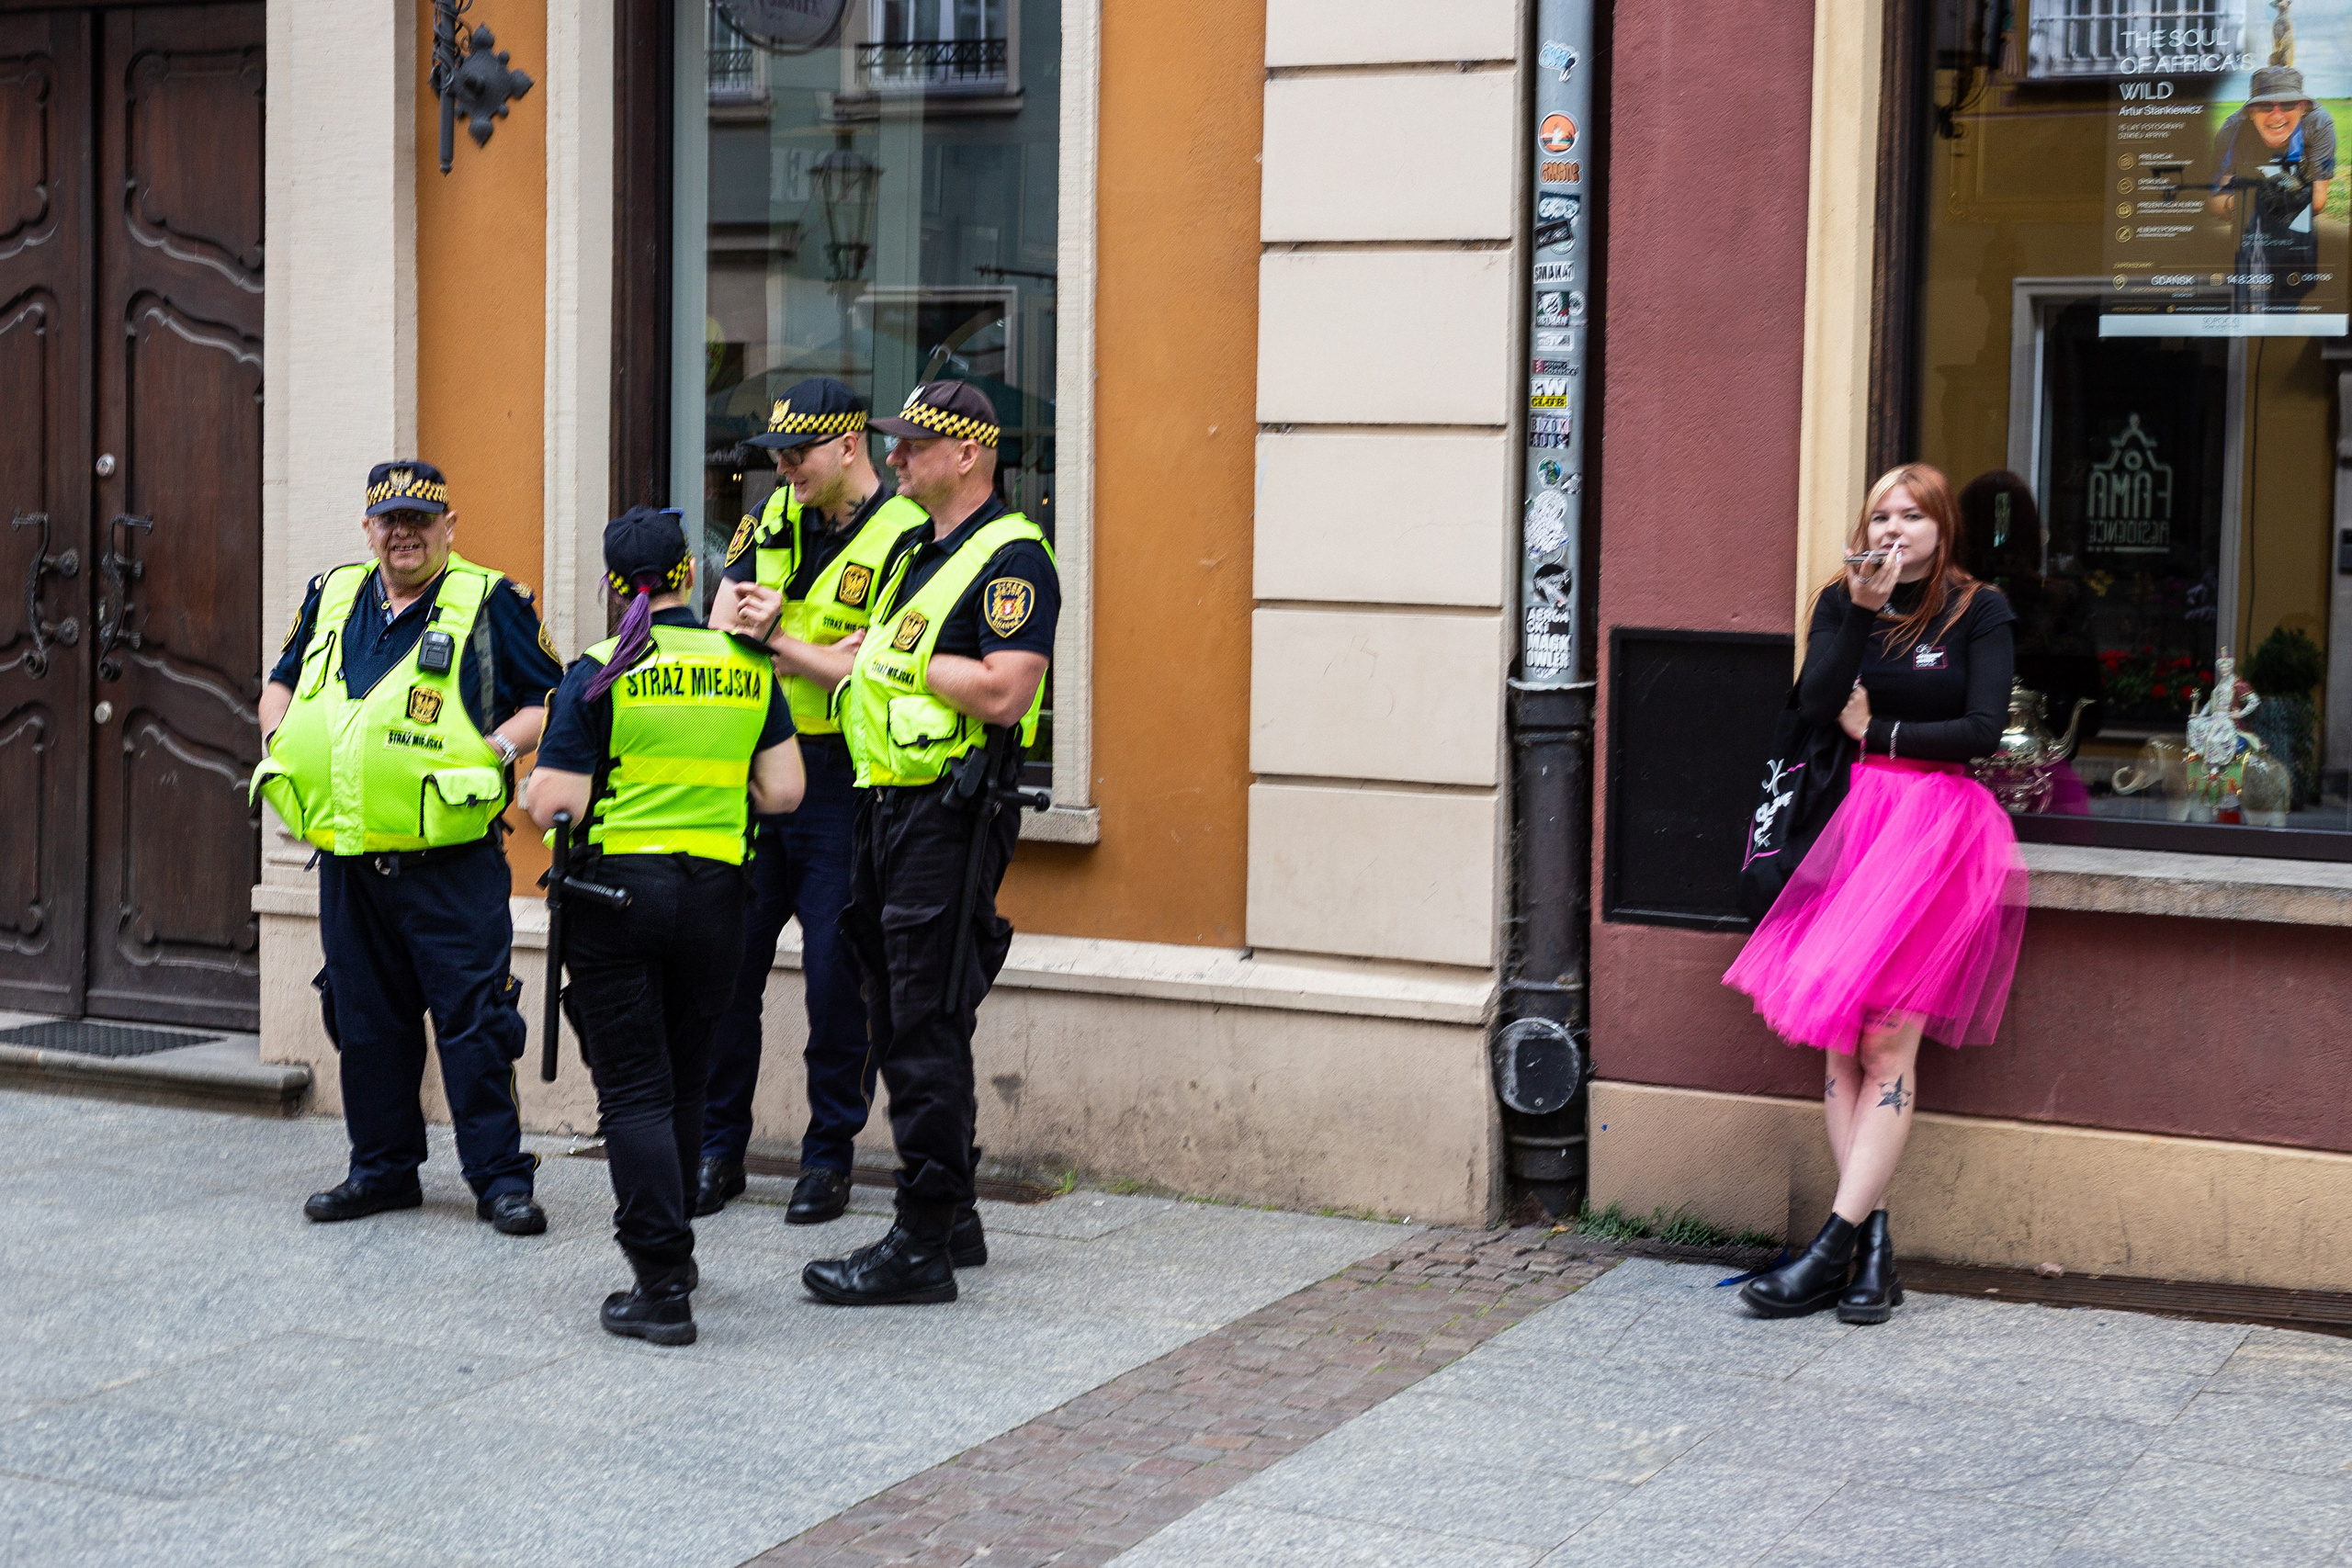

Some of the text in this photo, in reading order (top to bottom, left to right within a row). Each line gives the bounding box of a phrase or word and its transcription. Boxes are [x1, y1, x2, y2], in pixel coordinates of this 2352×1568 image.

[2120, 28, 2231, 50] THE SOUL
[2120, 52, 2256, 75] OF AFRICA'S
[2119, 81, 2175, 101] WILD
[2118, 103, 2204, 117] Artur Stankiewicz
[2151, 274, 2196, 286] GDAŃSK
[823, 615, 843, 631] STRAŻ
[627, 660, 762, 702] STRAŻ MIEJSKA
[887, 666, 915, 687] MIEJSKA
[388, 728, 412, 747] STRAŻ
